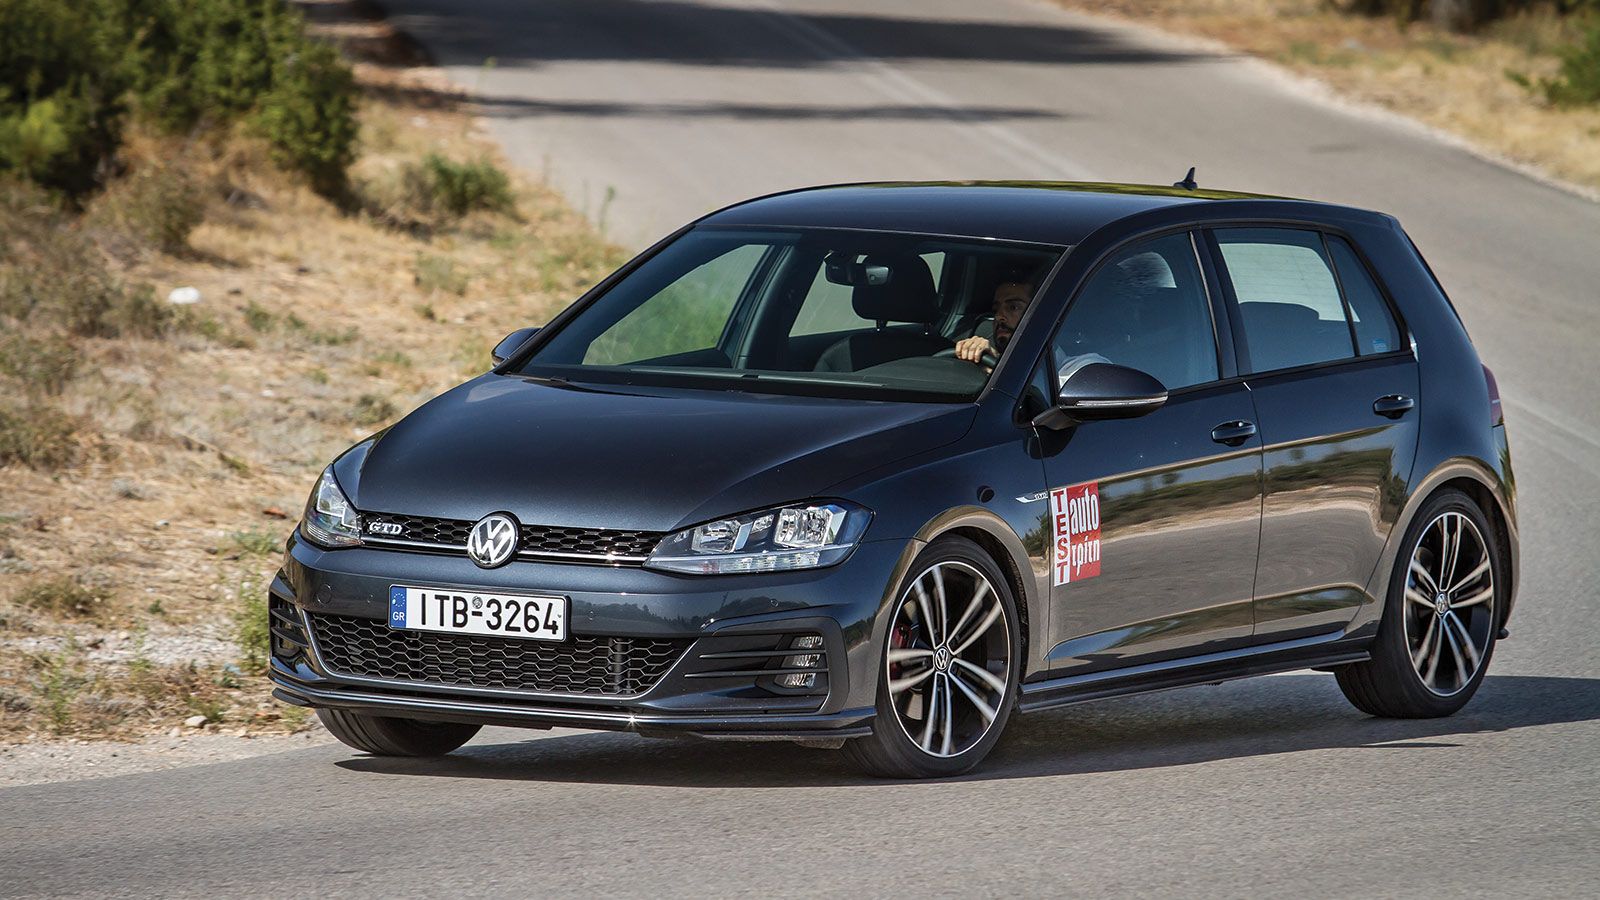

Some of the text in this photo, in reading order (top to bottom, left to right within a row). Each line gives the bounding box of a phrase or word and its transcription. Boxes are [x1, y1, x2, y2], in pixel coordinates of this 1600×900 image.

[369, 522, 402, 534] GTD
[1053, 490, 1068, 583] TEST
[1071, 535, 1100, 576] τρίτη
[392, 611, 405, 621] GR
